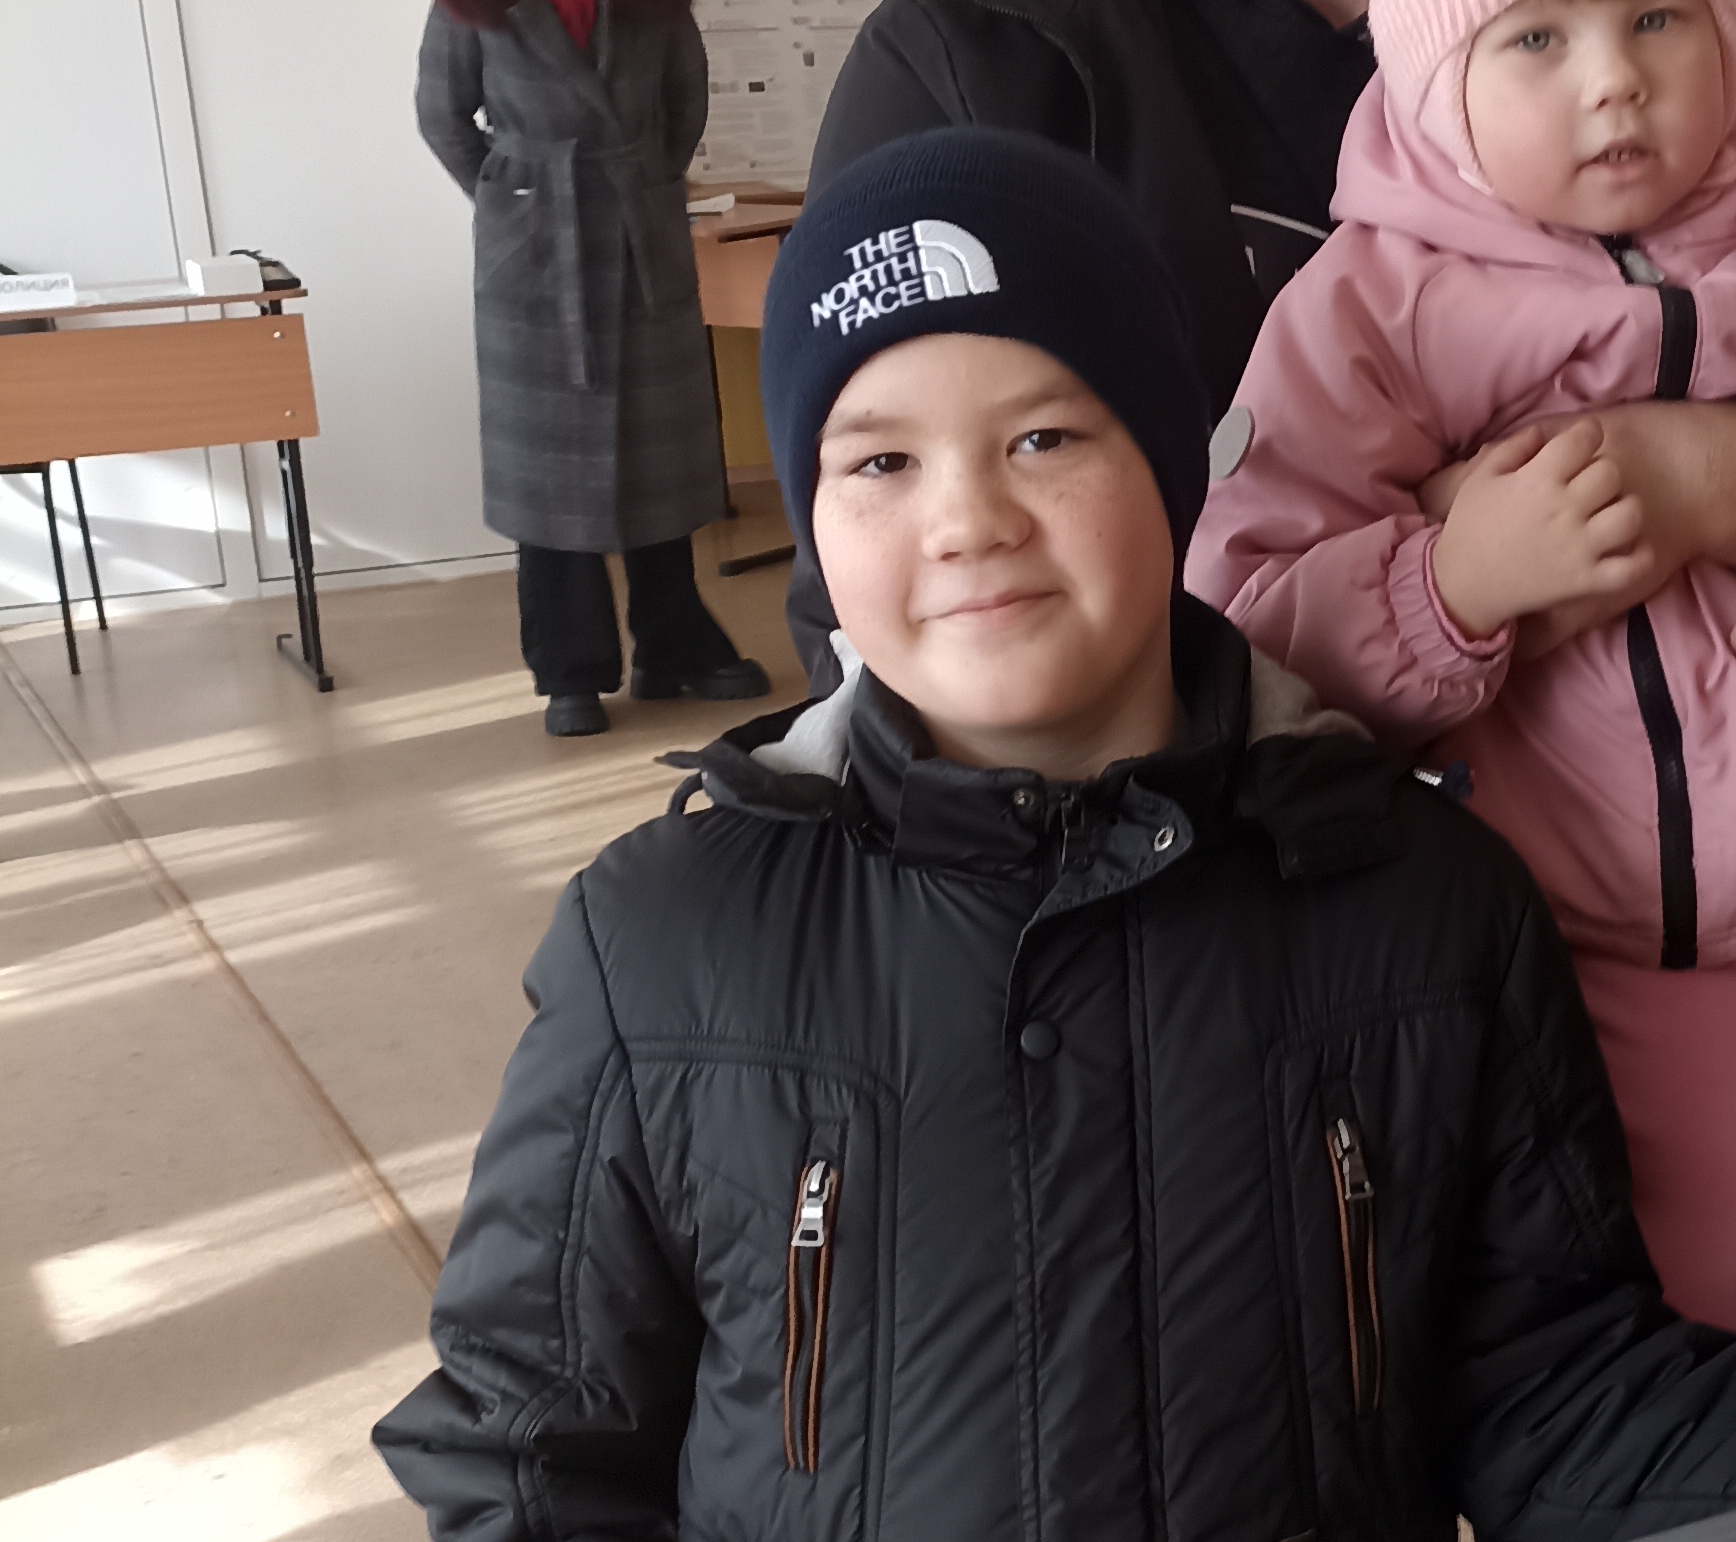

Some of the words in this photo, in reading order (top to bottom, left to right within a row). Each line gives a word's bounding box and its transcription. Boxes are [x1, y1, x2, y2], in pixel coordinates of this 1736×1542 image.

[843, 225, 914, 270] THE
[810, 251, 917, 328] NORTH
[838, 278, 925, 336] FACE
